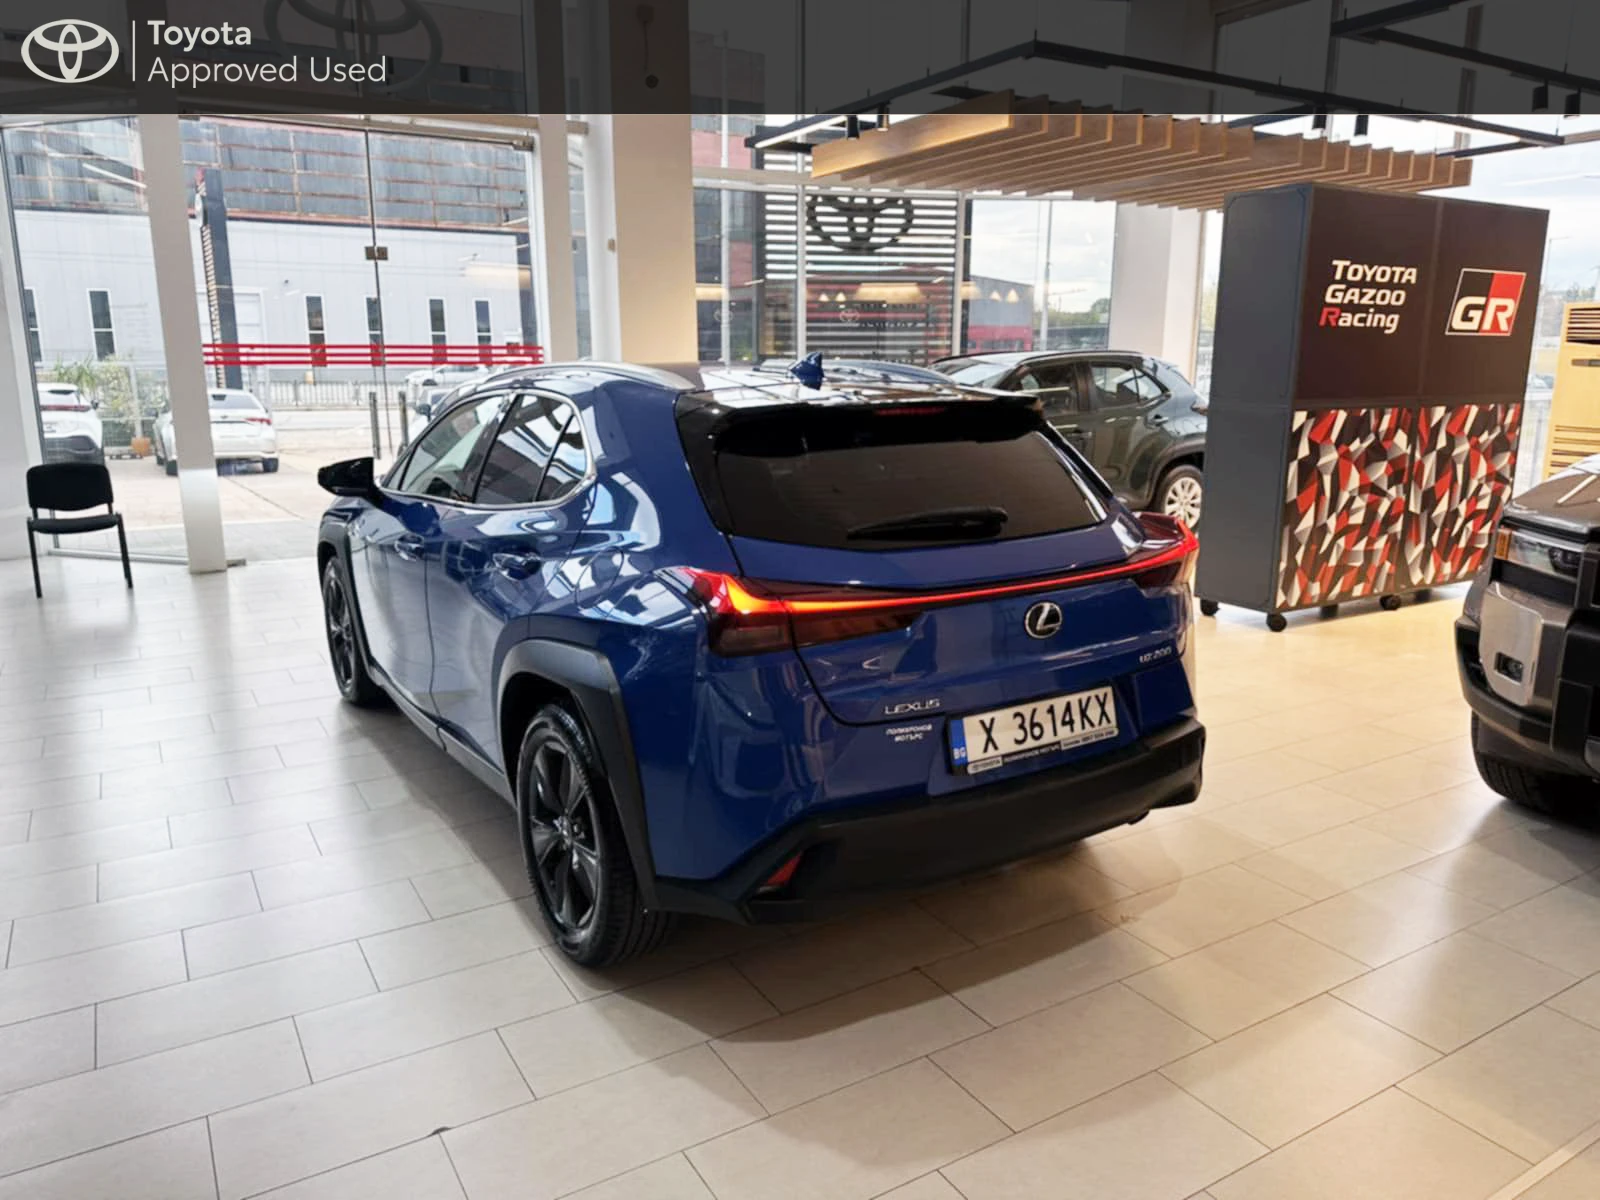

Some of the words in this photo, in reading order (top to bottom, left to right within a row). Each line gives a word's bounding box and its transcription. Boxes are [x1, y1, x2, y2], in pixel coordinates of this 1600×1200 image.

[1332, 259, 1418, 285] TOYOTA
[1325, 284, 1406, 306] GAZOO
[1319, 307, 1401, 335] Racing
[1450, 295, 1516, 332] GR
[885, 699, 941, 716] LEXUS
[979, 716, 1000, 754] X
[1012, 693, 1112, 746] 3614KX
[953, 747, 967, 760] BG
